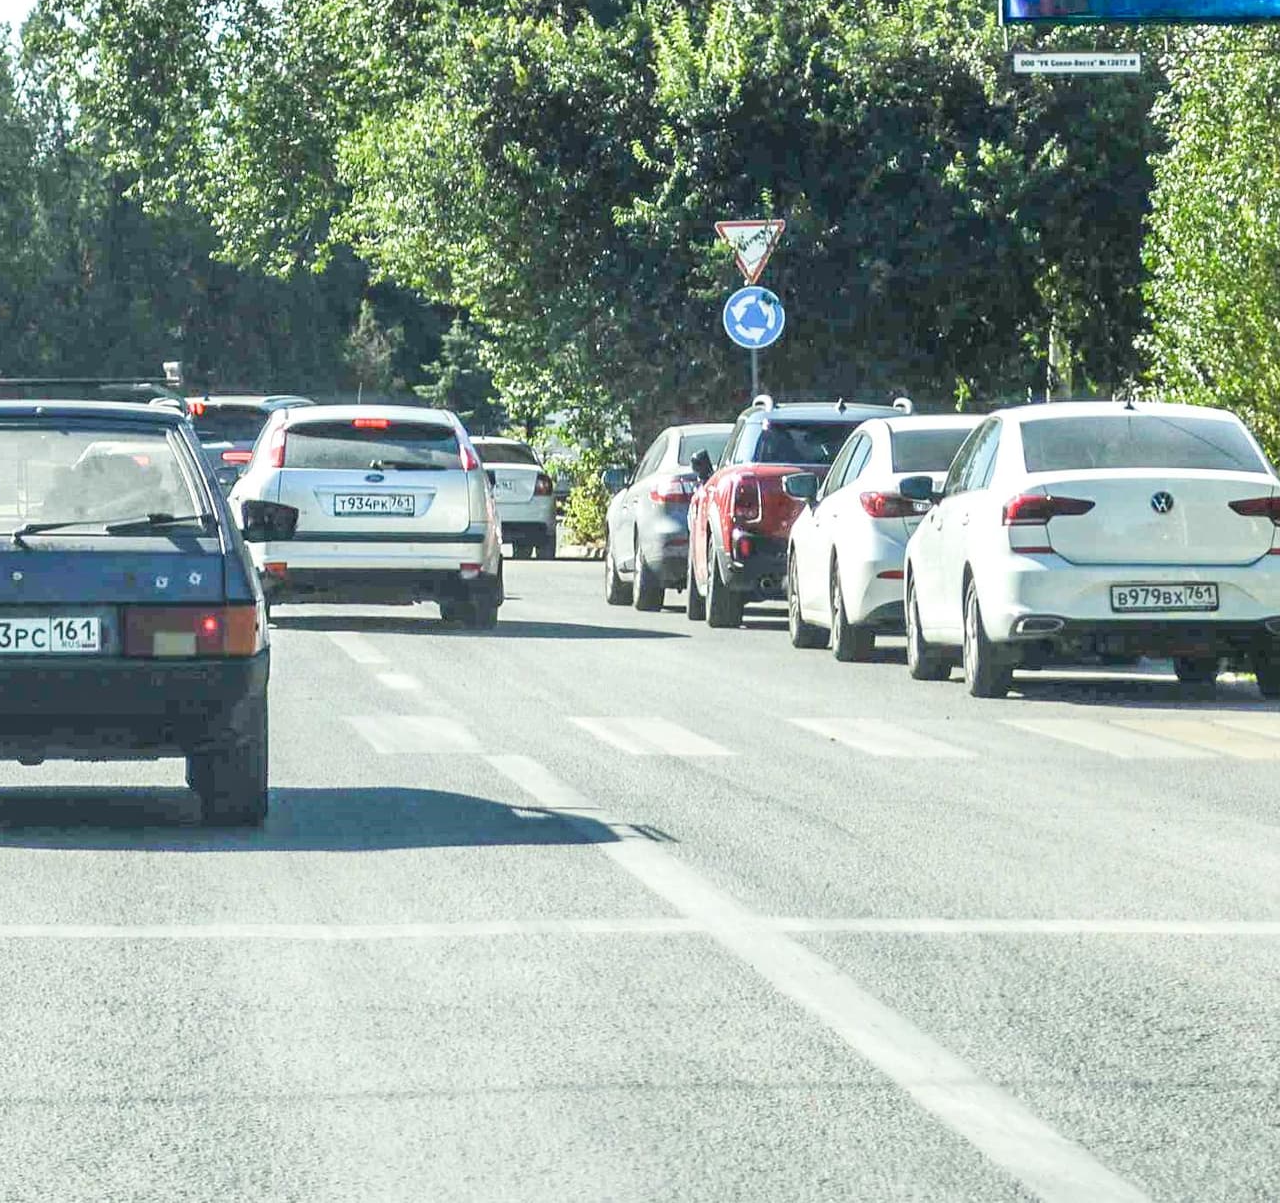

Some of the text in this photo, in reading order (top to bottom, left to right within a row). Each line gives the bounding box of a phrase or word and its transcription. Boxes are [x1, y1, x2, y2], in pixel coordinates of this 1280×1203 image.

[1118, 587, 1212, 605] В979ВХ 761
[53, 620, 91, 641] 161
